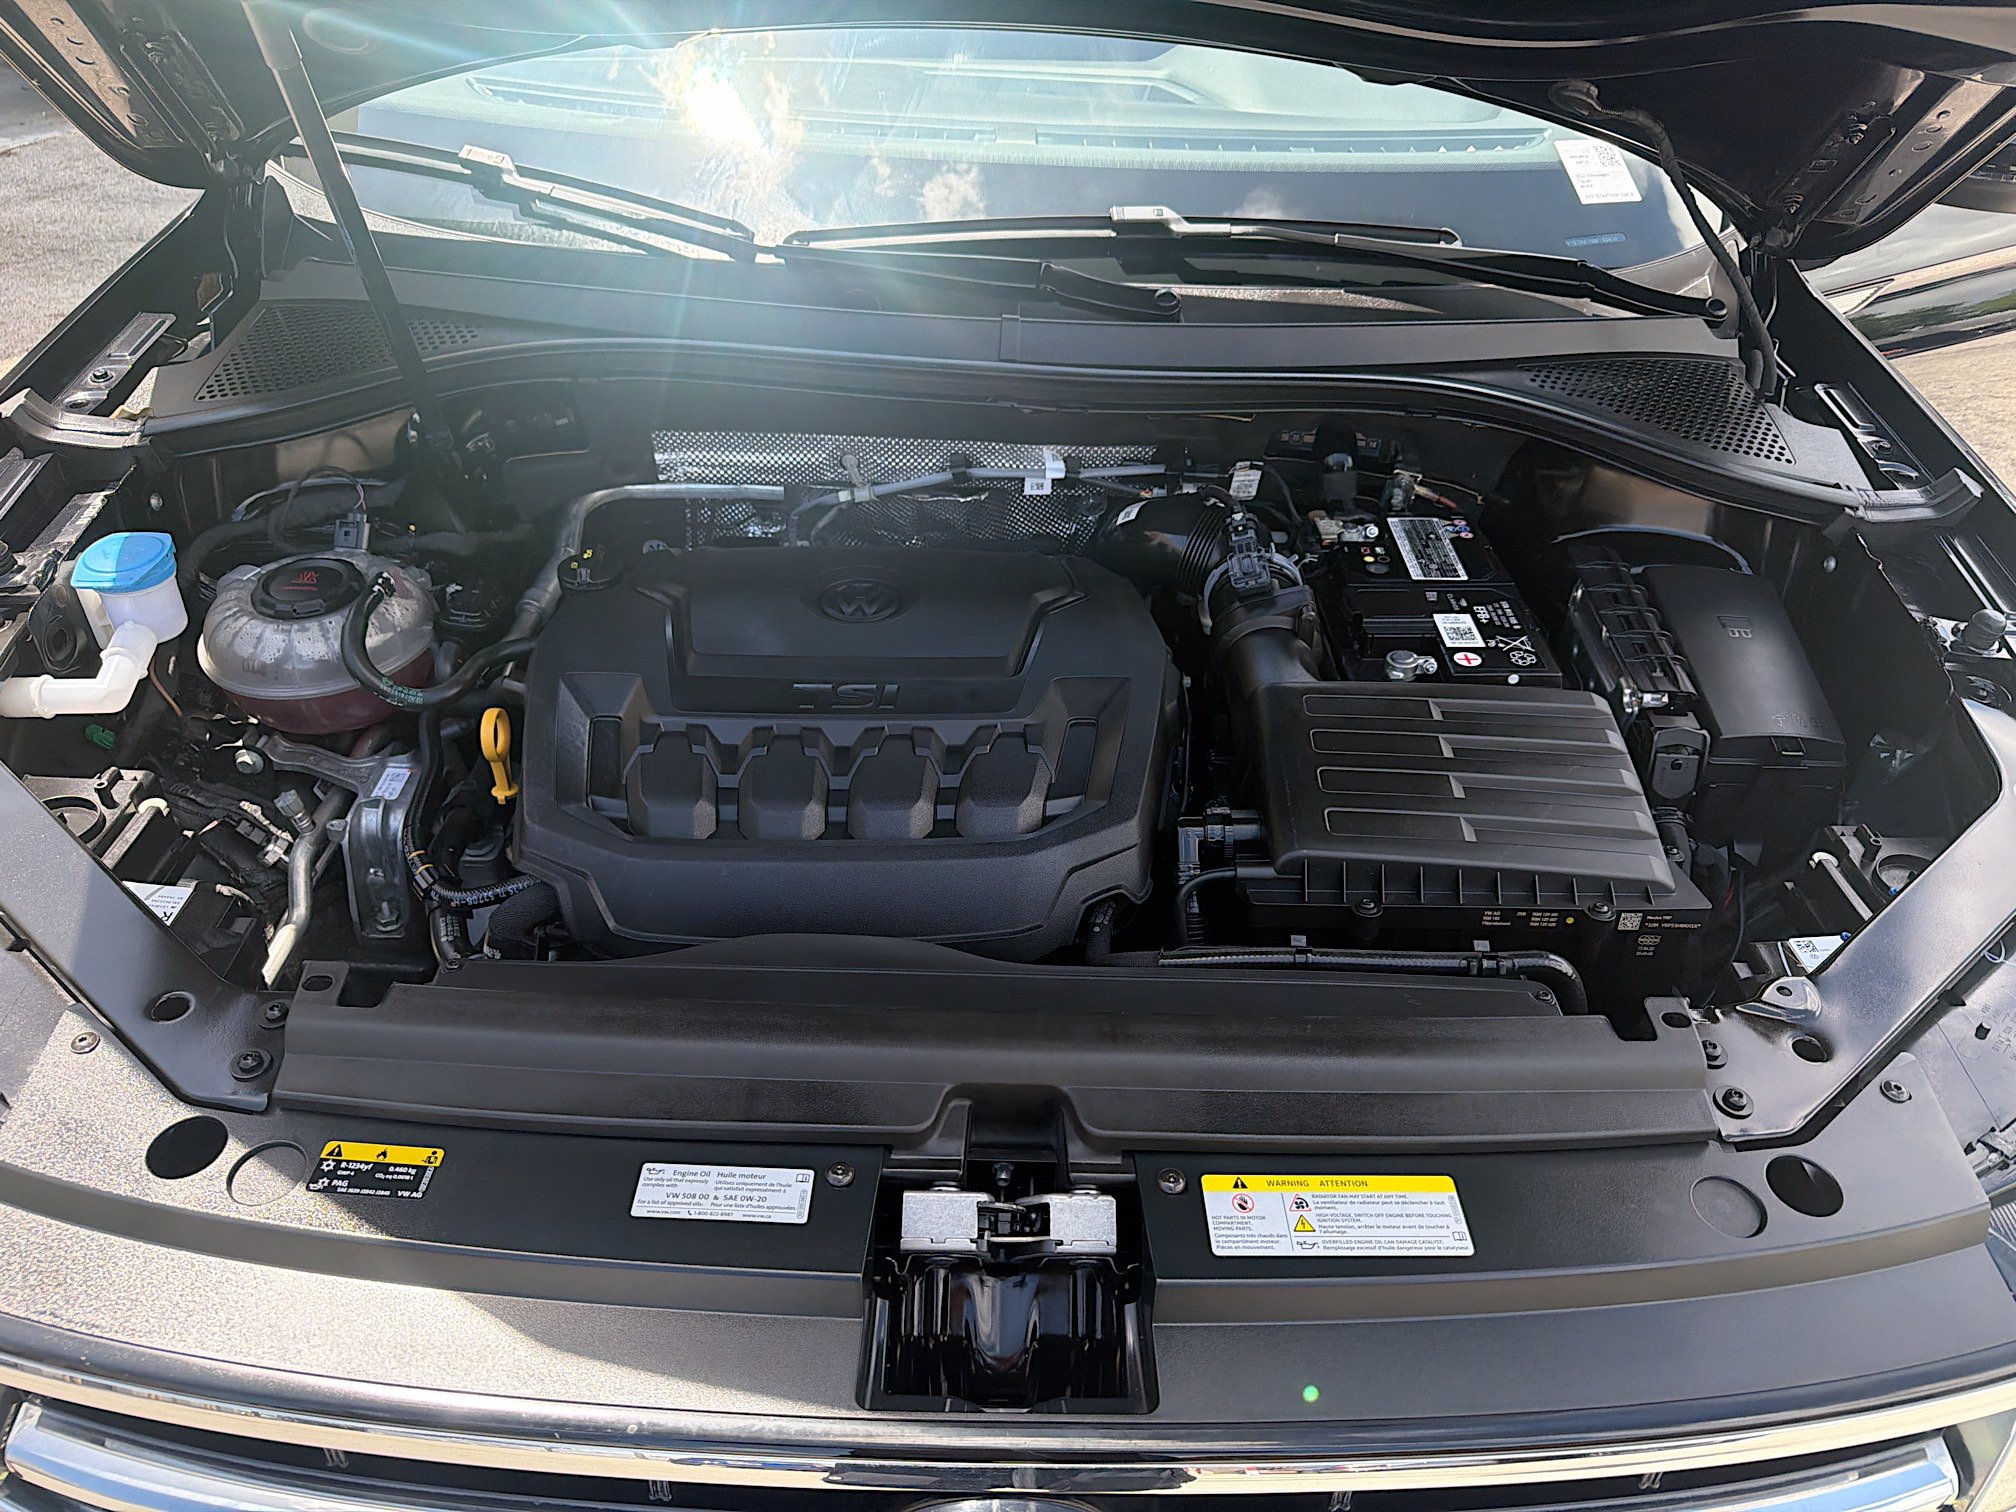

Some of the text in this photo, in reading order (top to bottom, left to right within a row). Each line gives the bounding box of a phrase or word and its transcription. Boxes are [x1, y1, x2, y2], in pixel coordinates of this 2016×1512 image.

[1473, 606, 1490, 624] EFB+
[792, 683, 899, 710] TSI
[161, 912, 173, 922] R
[340, 1162, 373, 1171] R-1234yf
[408, 1167, 417, 1175] kg
[673, 1170, 698, 1178] Engine
[1319, 1180, 1368, 1188] ATTENTION
